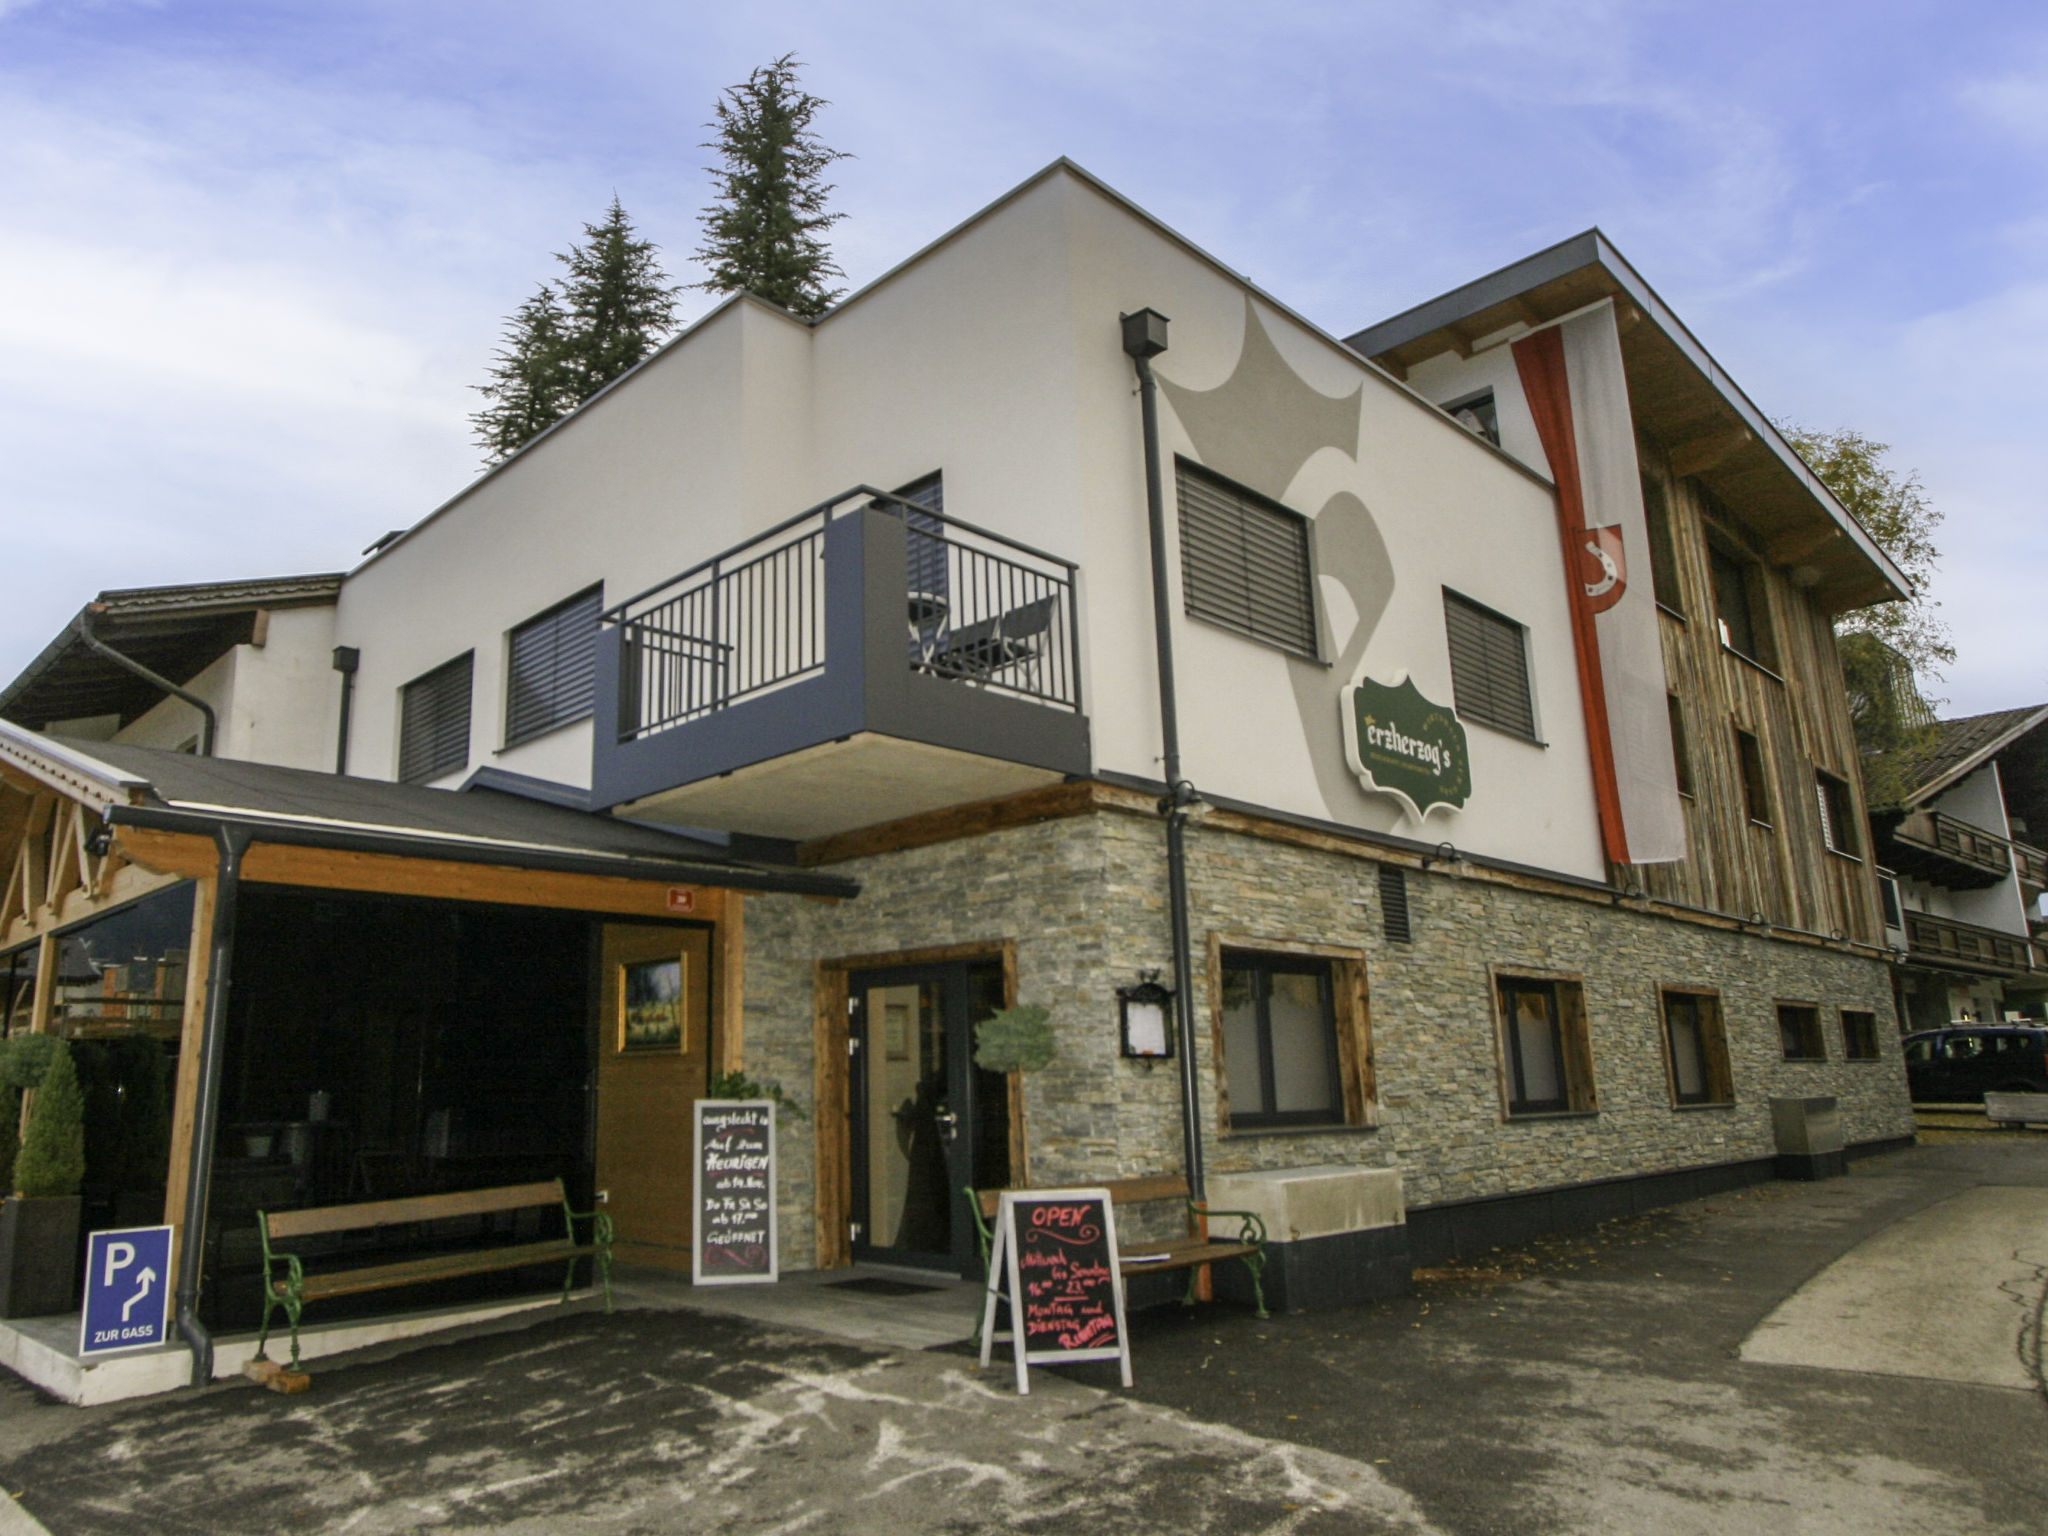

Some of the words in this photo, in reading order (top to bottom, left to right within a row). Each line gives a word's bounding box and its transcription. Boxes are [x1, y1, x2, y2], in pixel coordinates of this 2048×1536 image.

[1367, 721, 1452, 776] erzherzog's
[1031, 1205, 1091, 1227] OPEN
[104, 1241, 136, 1287] P
[94, 1329, 119, 1343] ZUR
[121, 1325, 154, 1340] GASS
